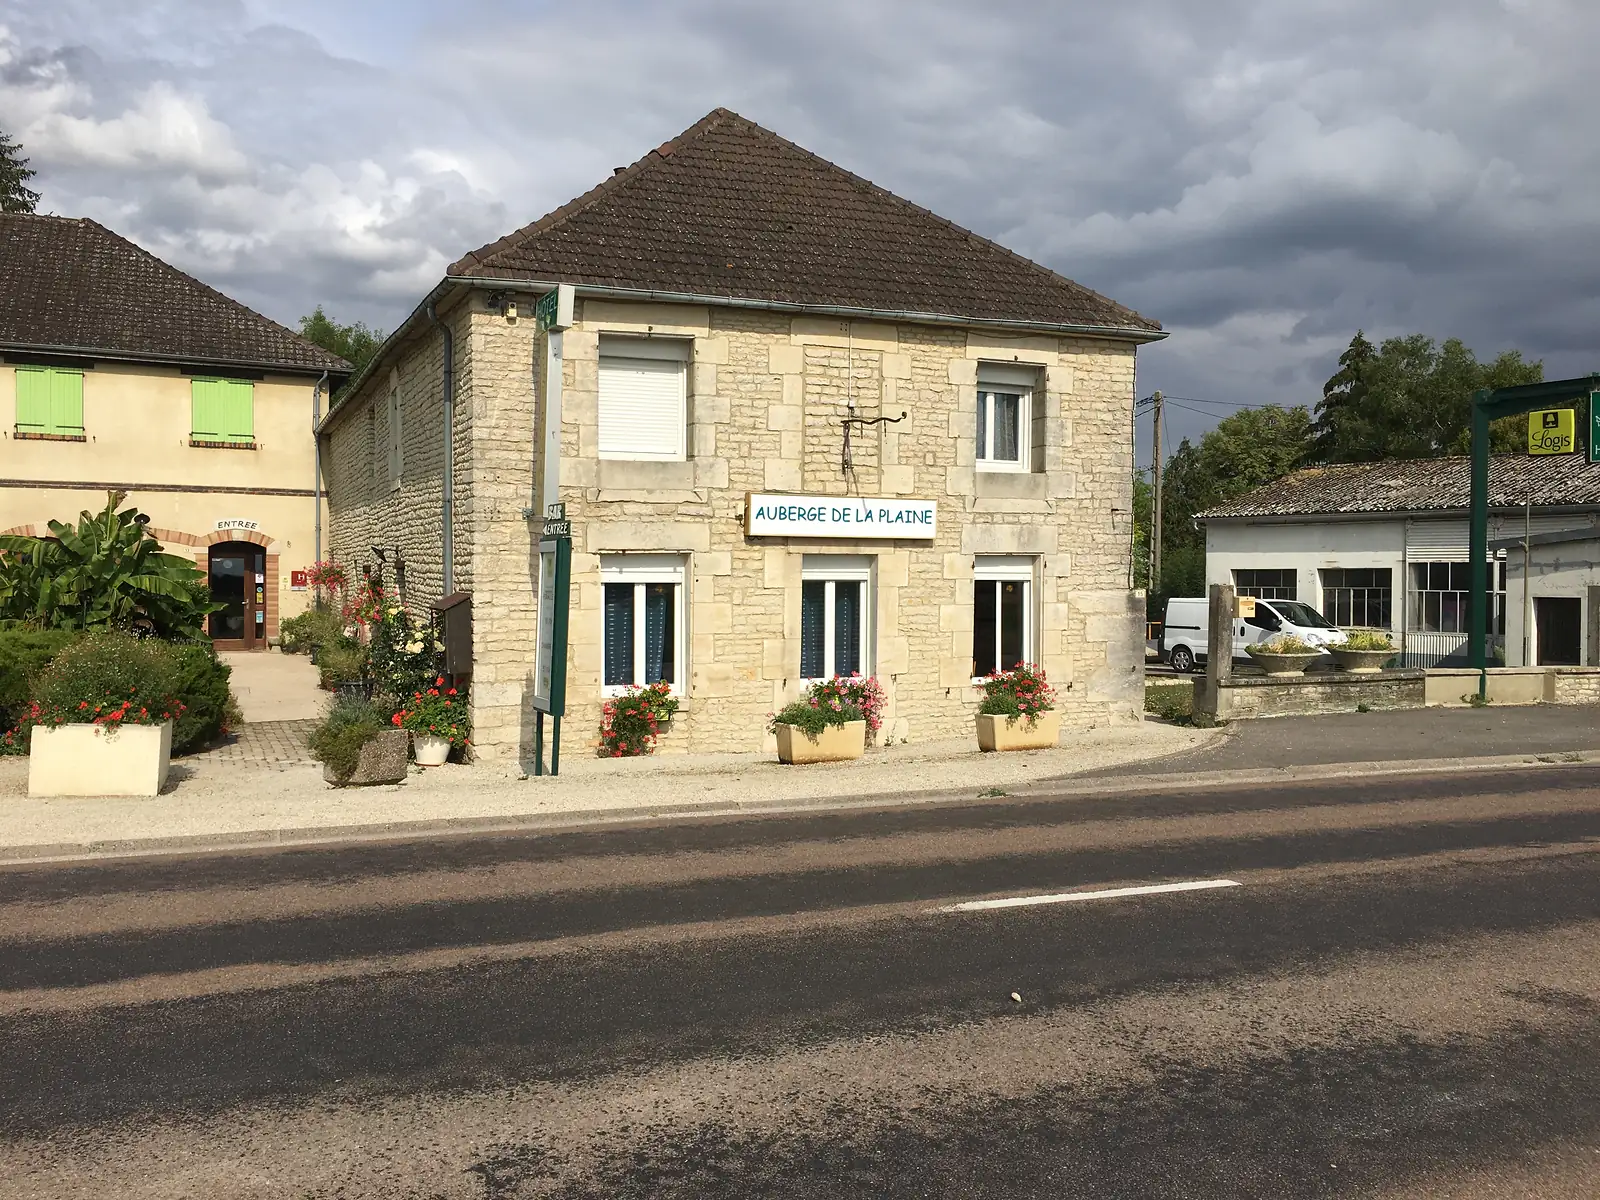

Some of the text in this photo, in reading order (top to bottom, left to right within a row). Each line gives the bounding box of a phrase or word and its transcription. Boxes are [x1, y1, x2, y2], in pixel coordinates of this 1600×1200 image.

[1530, 429, 1570, 452] Logis
[548, 504, 562, 520] BAR
[755, 506, 932, 524] AUBERGE DE LA PLAINE
[217, 520, 257, 530] ENTREE
